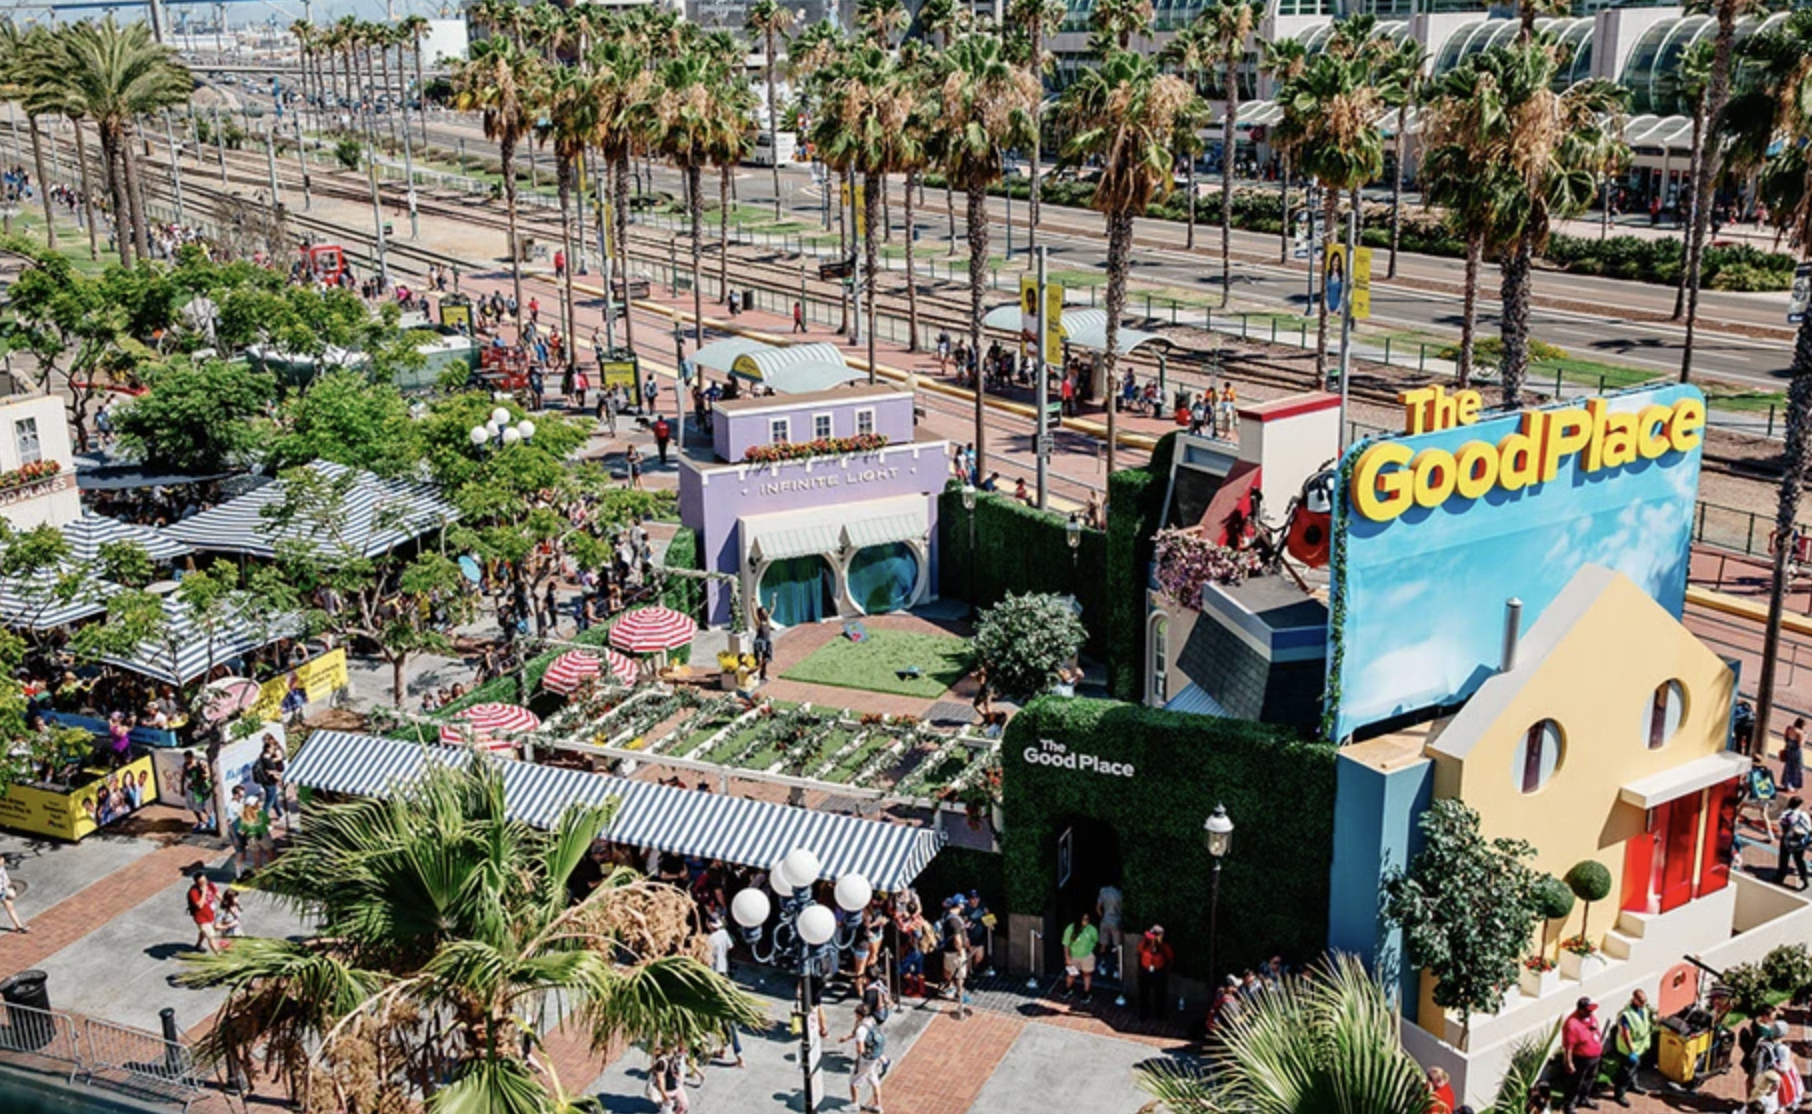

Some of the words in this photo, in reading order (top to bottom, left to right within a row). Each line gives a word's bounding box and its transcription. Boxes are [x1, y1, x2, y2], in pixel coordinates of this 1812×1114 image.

[1399, 386, 1482, 434] The
[1350, 412, 1545, 521] Good
[1539, 398, 1705, 481] Place
[20, 477, 67, 499] PLATES
[760, 476, 840, 496] INFINITE
[846, 467, 899, 485] LIGHT
[1039, 738, 1067, 754] The
[1023, 748, 1076, 768] Good
[1079, 754, 1135, 777] Place
